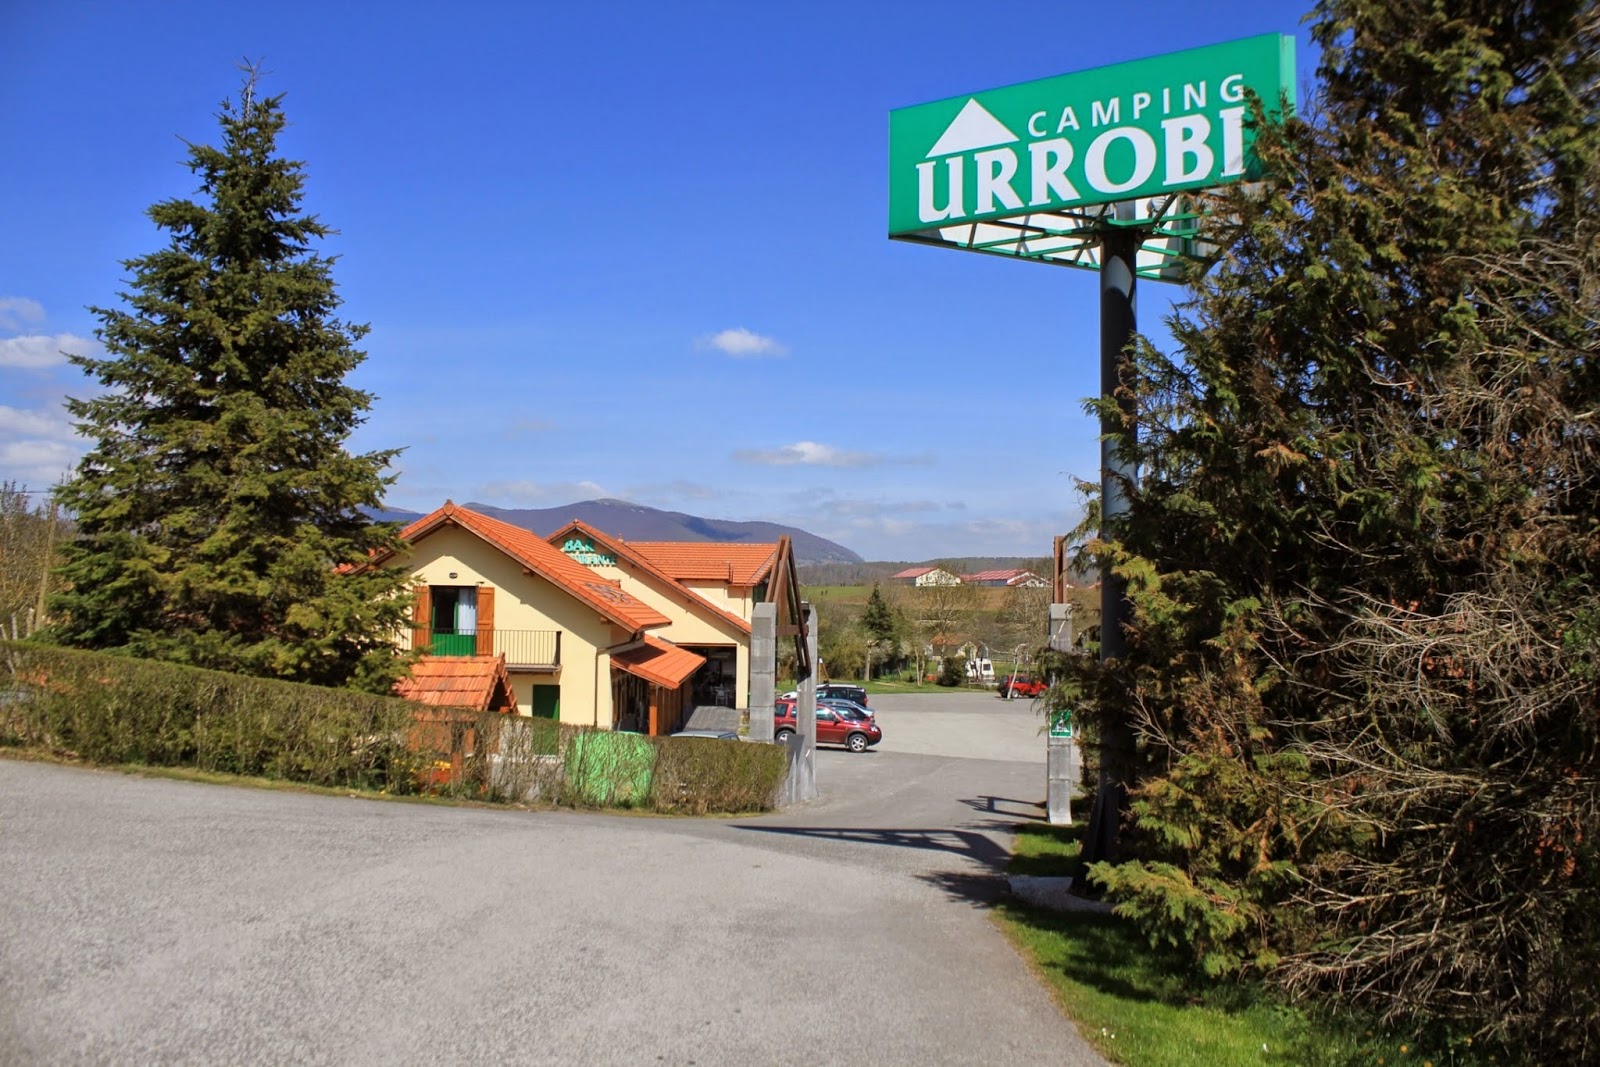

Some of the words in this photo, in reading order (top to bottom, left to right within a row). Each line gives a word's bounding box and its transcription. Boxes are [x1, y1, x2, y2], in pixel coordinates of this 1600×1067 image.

[1027, 73, 1245, 138] CAMPING
[915, 106, 1246, 223] URROBI
[564, 539, 595, 552] BAR
